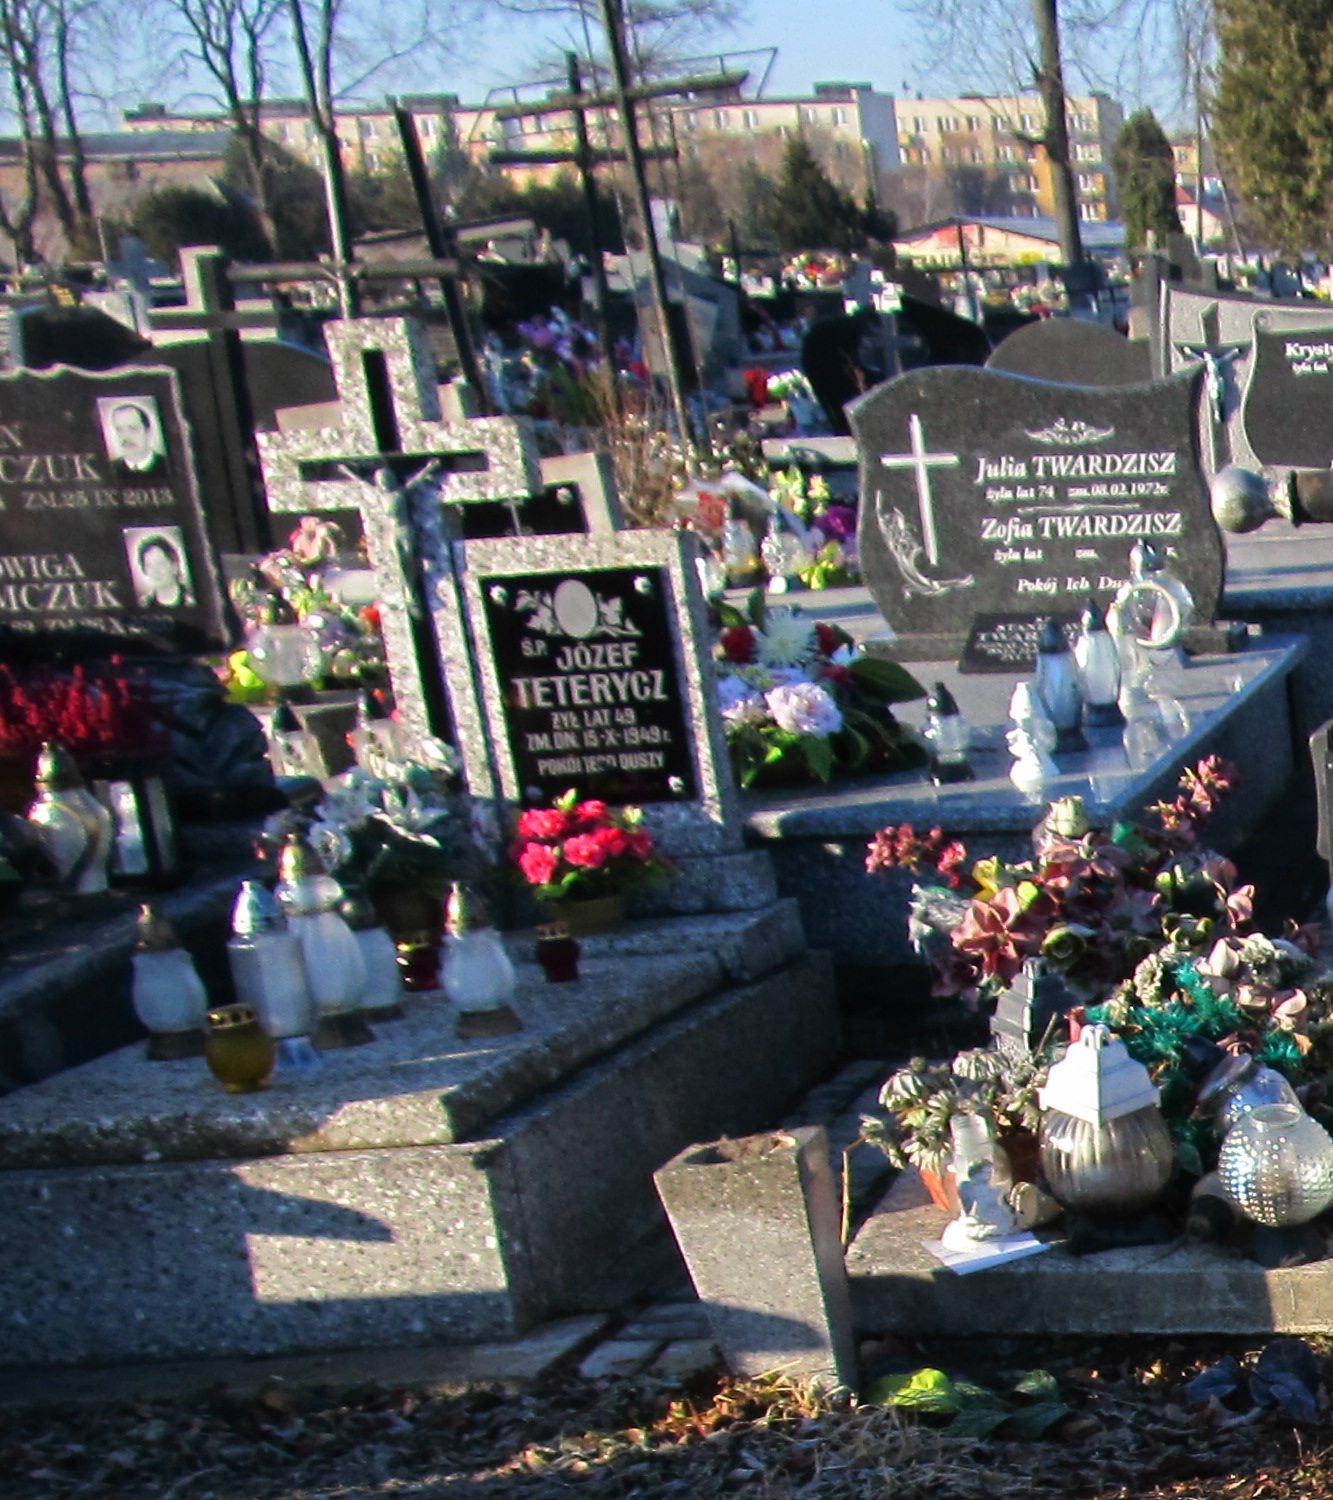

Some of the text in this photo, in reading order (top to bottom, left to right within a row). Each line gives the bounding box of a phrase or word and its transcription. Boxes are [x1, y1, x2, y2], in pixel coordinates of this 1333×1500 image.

[974, 452, 1177, 485] Julia TWARDZISZ
[981, 513, 1183, 545] Zofia TWARDZISZ
[0, 553, 85, 579] WIGA
[1017, 577, 1058, 594] Pokój
[555, 642, 640, 671] JÓZEF
[511, 669, 668, 709] TETERYCZ
[583, 709, 610, 728] LAT
[614, 708, 636, 724] 49
